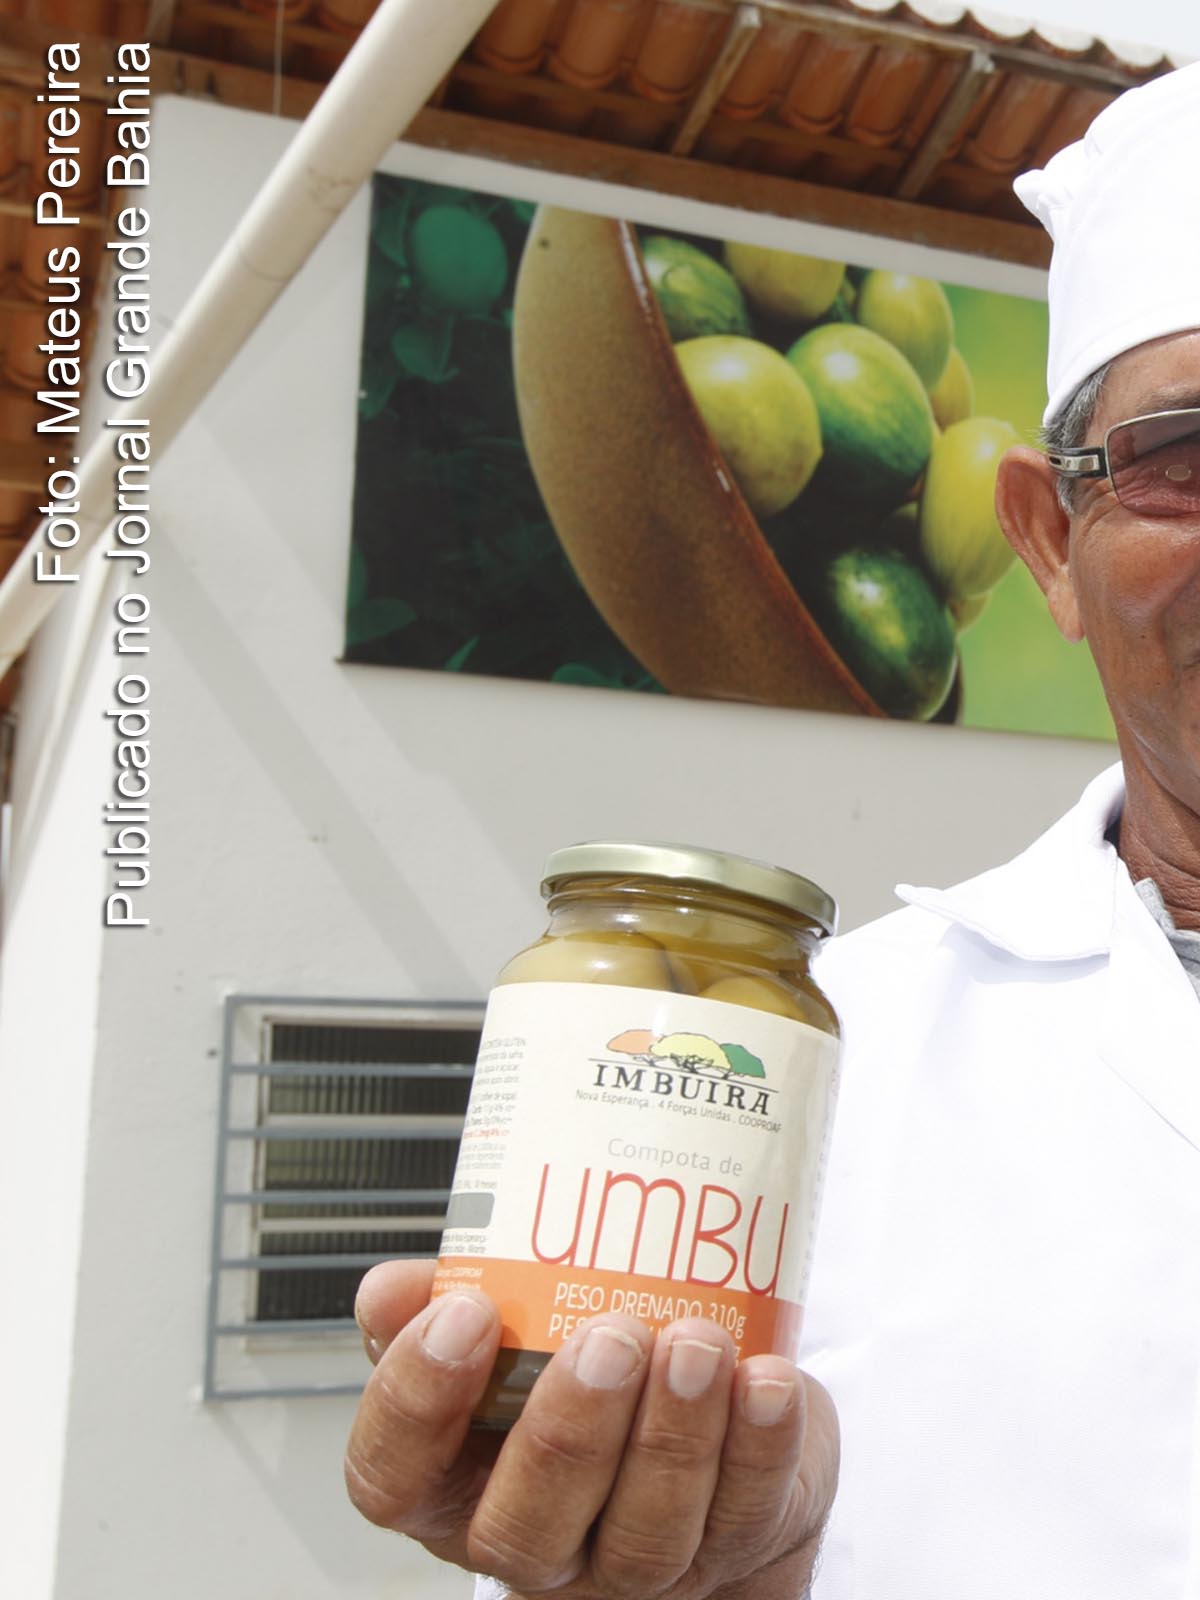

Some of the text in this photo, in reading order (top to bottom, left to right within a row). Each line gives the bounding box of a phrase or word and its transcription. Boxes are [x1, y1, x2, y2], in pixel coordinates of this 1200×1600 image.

[575, 1089, 599, 1101] Nova
[601, 1091, 650, 1110] Esperança
[658, 1100, 665, 1109] 4
[667, 1101, 698, 1116] Forças
[700, 1106, 732, 1123] Unidas
[592, 1064, 771, 1116] IMBUIRA
[607, 1137, 744, 1177] Compota de
[553, 1282, 747, 1340] PESO DRENADO 310g
